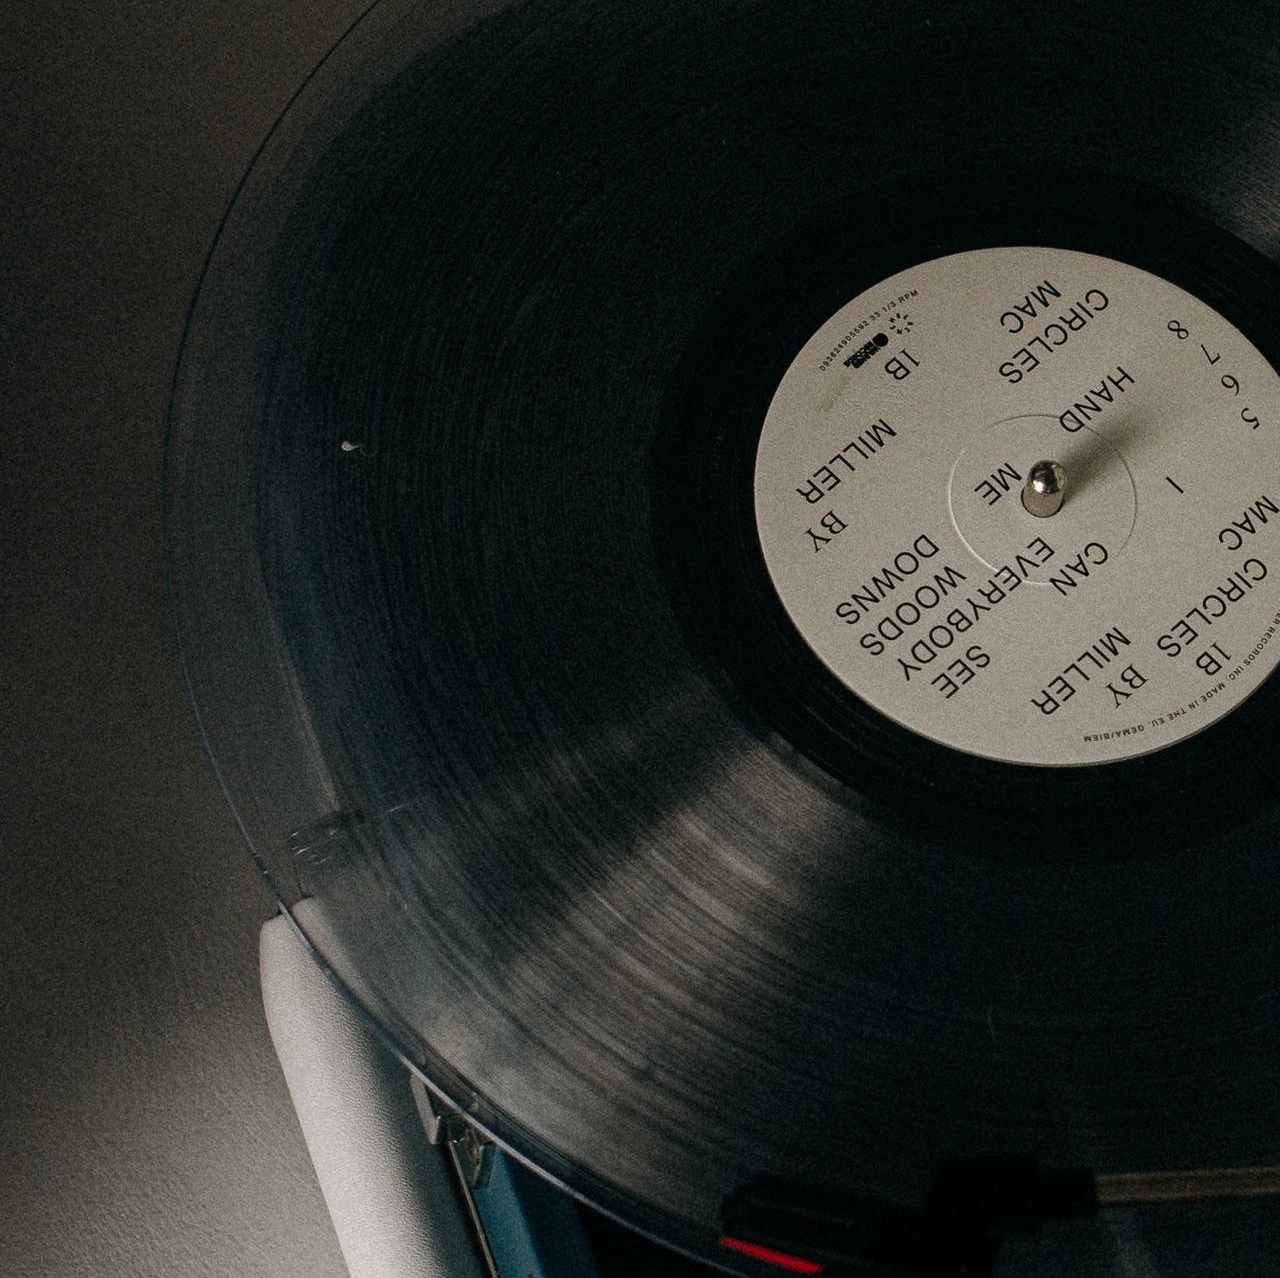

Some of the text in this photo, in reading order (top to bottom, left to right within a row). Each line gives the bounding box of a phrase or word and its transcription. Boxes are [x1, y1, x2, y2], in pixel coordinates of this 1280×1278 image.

[869, 311, 881, 321] 33
[882, 301, 896, 312] 1/3
[898, 290, 919, 303] RPM
[796, 280, 1061, 504] MAC MILLER
[885, 349, 920, 380] 1B
[805, 289, 1109, 553] CIRCLES BY
[836, 320, 1189, 624] 8 HAND ME DOWNS
[860, 344, 1220, 655] 7 WOODS
[897, 375, 1239, 681] 6 EVERYBODY
[931, 408, 1260, 699] 5 I CAN SEE
[1031, 496, 1280, 715] MAC MILLER
[1106, 559, 1267, 708] CIRCLES BY
[1243, 626, 1276, 665] RECORDS
[1188, 699, 1199, 710] IN
[1196, 642, 1231, 675] 1B
[1199, 682, 1226, 702] MADE
[1084, 724, 1145, 742] GEMA/BIEM
[1167, 708, 1187, 721] THE
